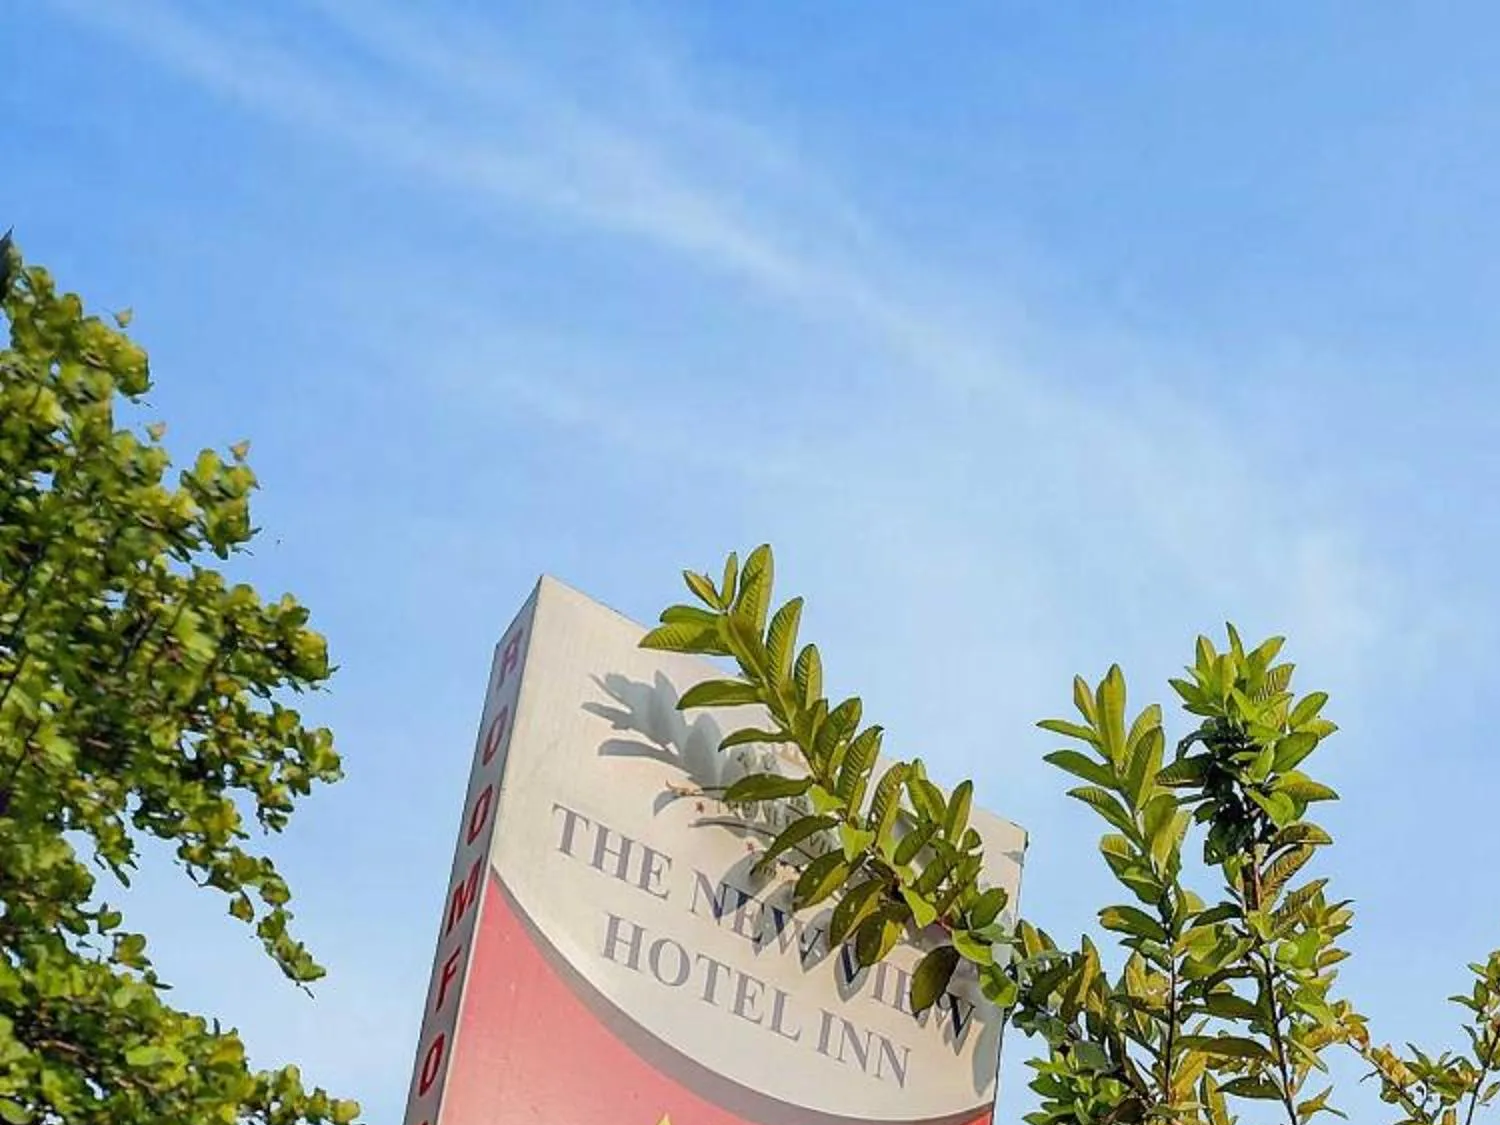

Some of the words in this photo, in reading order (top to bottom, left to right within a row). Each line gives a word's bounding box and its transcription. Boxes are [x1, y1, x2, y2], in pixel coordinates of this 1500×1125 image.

[446, 627, 525, 938] ROOM
[551, 803, 673, 901] THE
[688, 867, 825, 968] NEW
[599, 913, 802, 1042] HOTEL
[816, 1007, 912, 1089] INN
